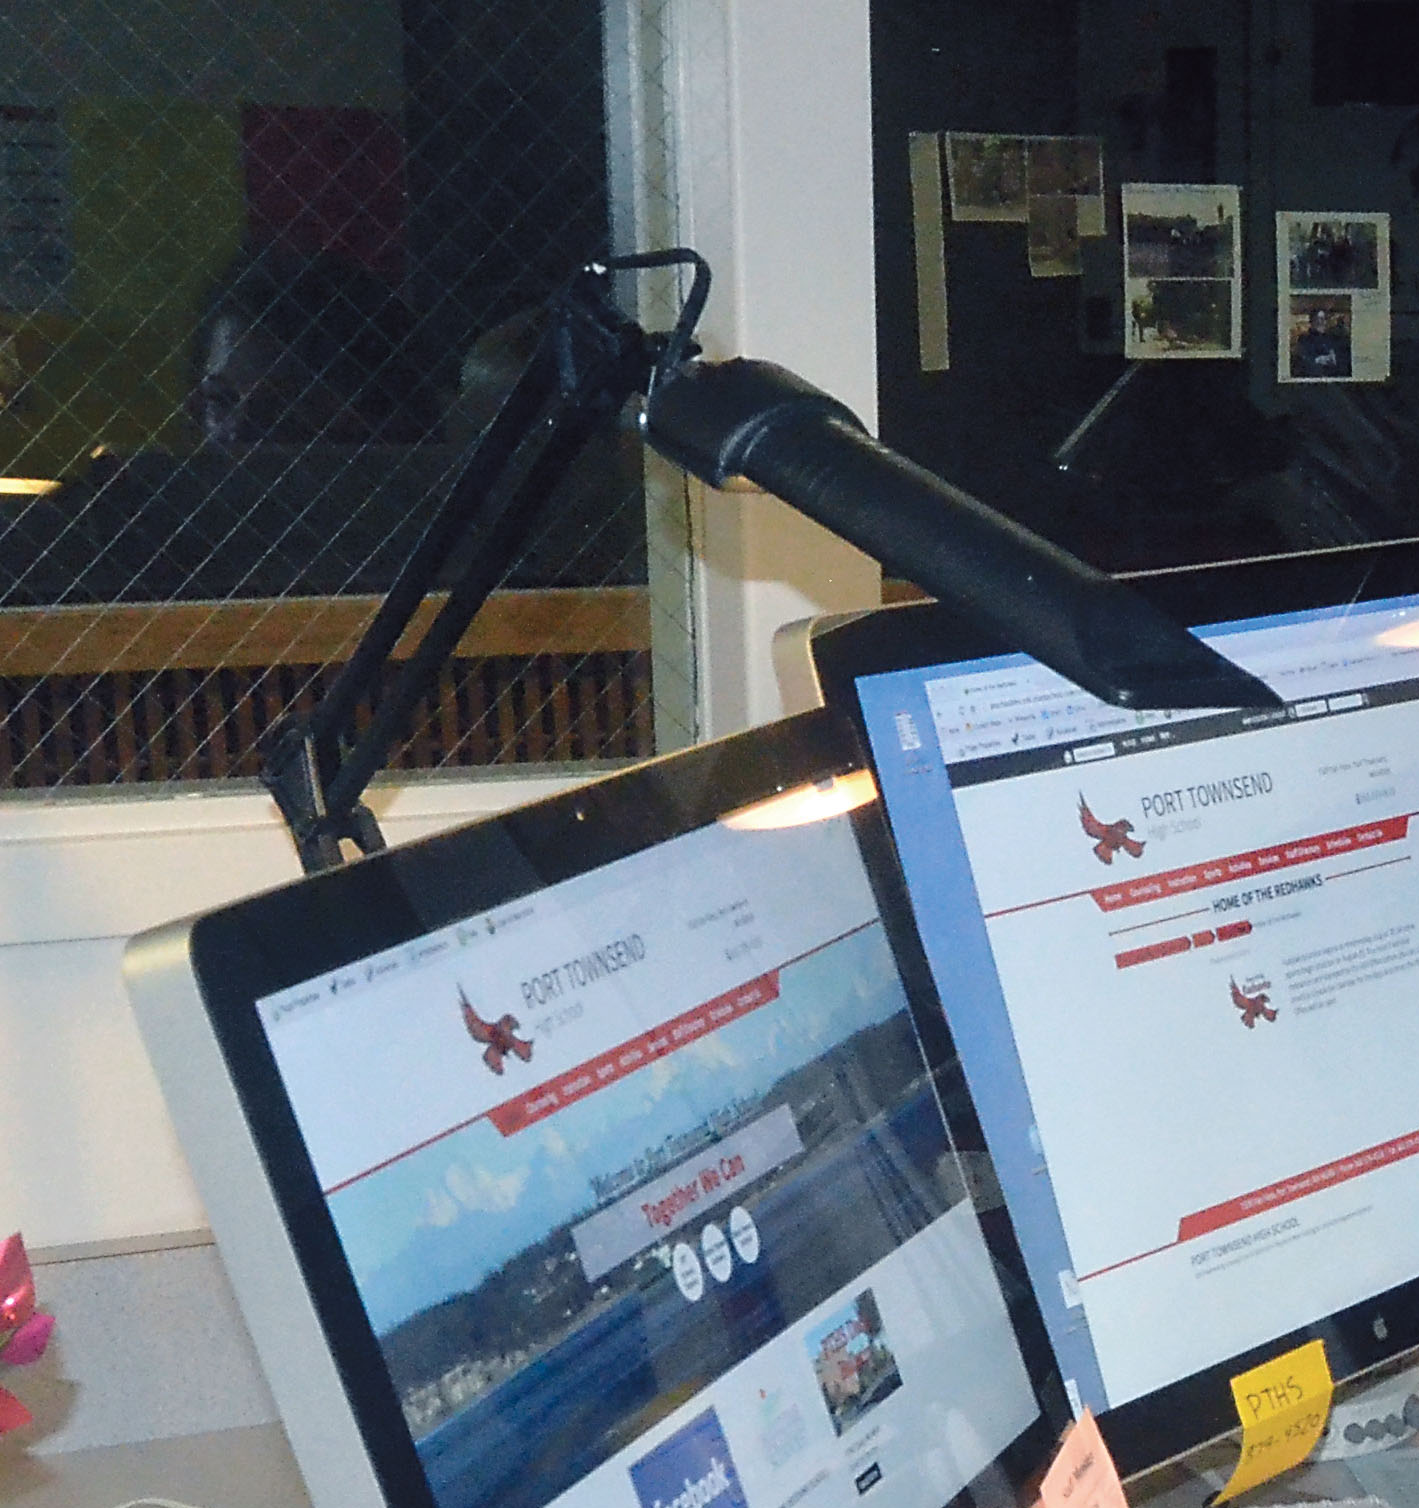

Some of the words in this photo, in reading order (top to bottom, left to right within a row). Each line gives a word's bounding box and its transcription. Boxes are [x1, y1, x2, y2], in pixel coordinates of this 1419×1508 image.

[1142, 789, 1186, 819] PORT
[1185, 771, 1274, 808] TOWNSEND
[1211, 891, 1241, 914] HOME
[1240, 888, 1254, 907] OF
[1254, 883, 1273, 903] THE
[1271, 872, 1324, 900] REDHAWKS
[520, 967, 563, 1009] PORT
[564, 932, 646, 988] TOWNSEND
[719, 1154, 746, 1182] Can
[1246, 1375, 1303, 1420] PTHS
